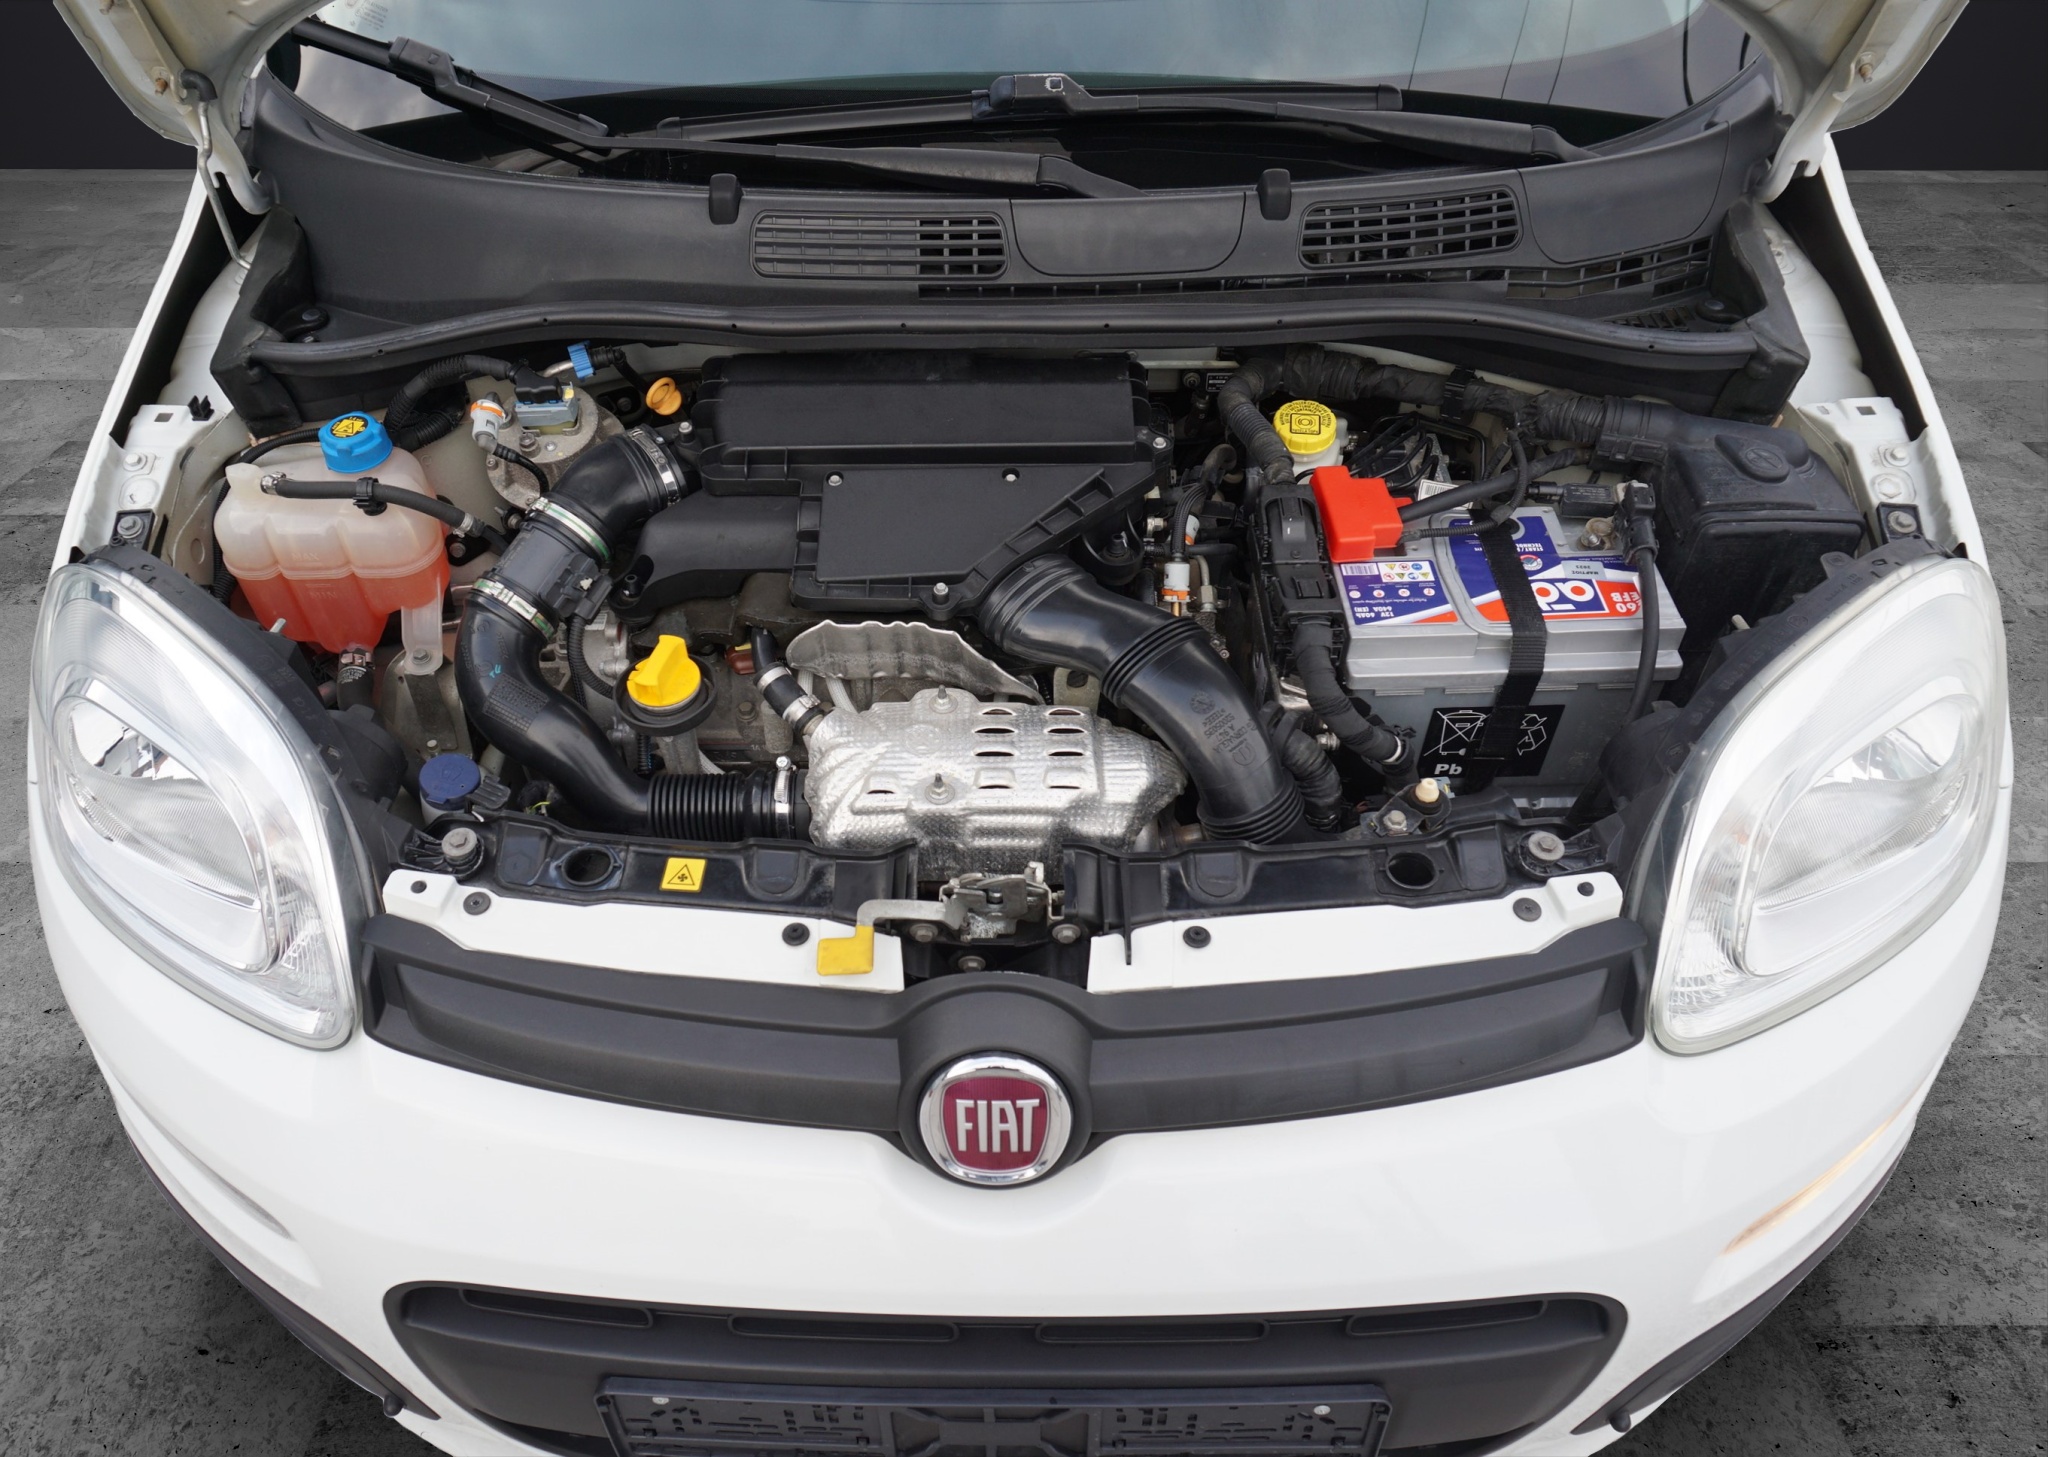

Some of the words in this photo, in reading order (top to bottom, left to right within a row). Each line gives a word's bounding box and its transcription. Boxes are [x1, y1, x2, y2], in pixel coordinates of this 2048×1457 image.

[1610, 592, 1640, 602] EFB
[1434, 764, 1462, 774] Pb
[956, 1098, 1040, 1153] FIAT
